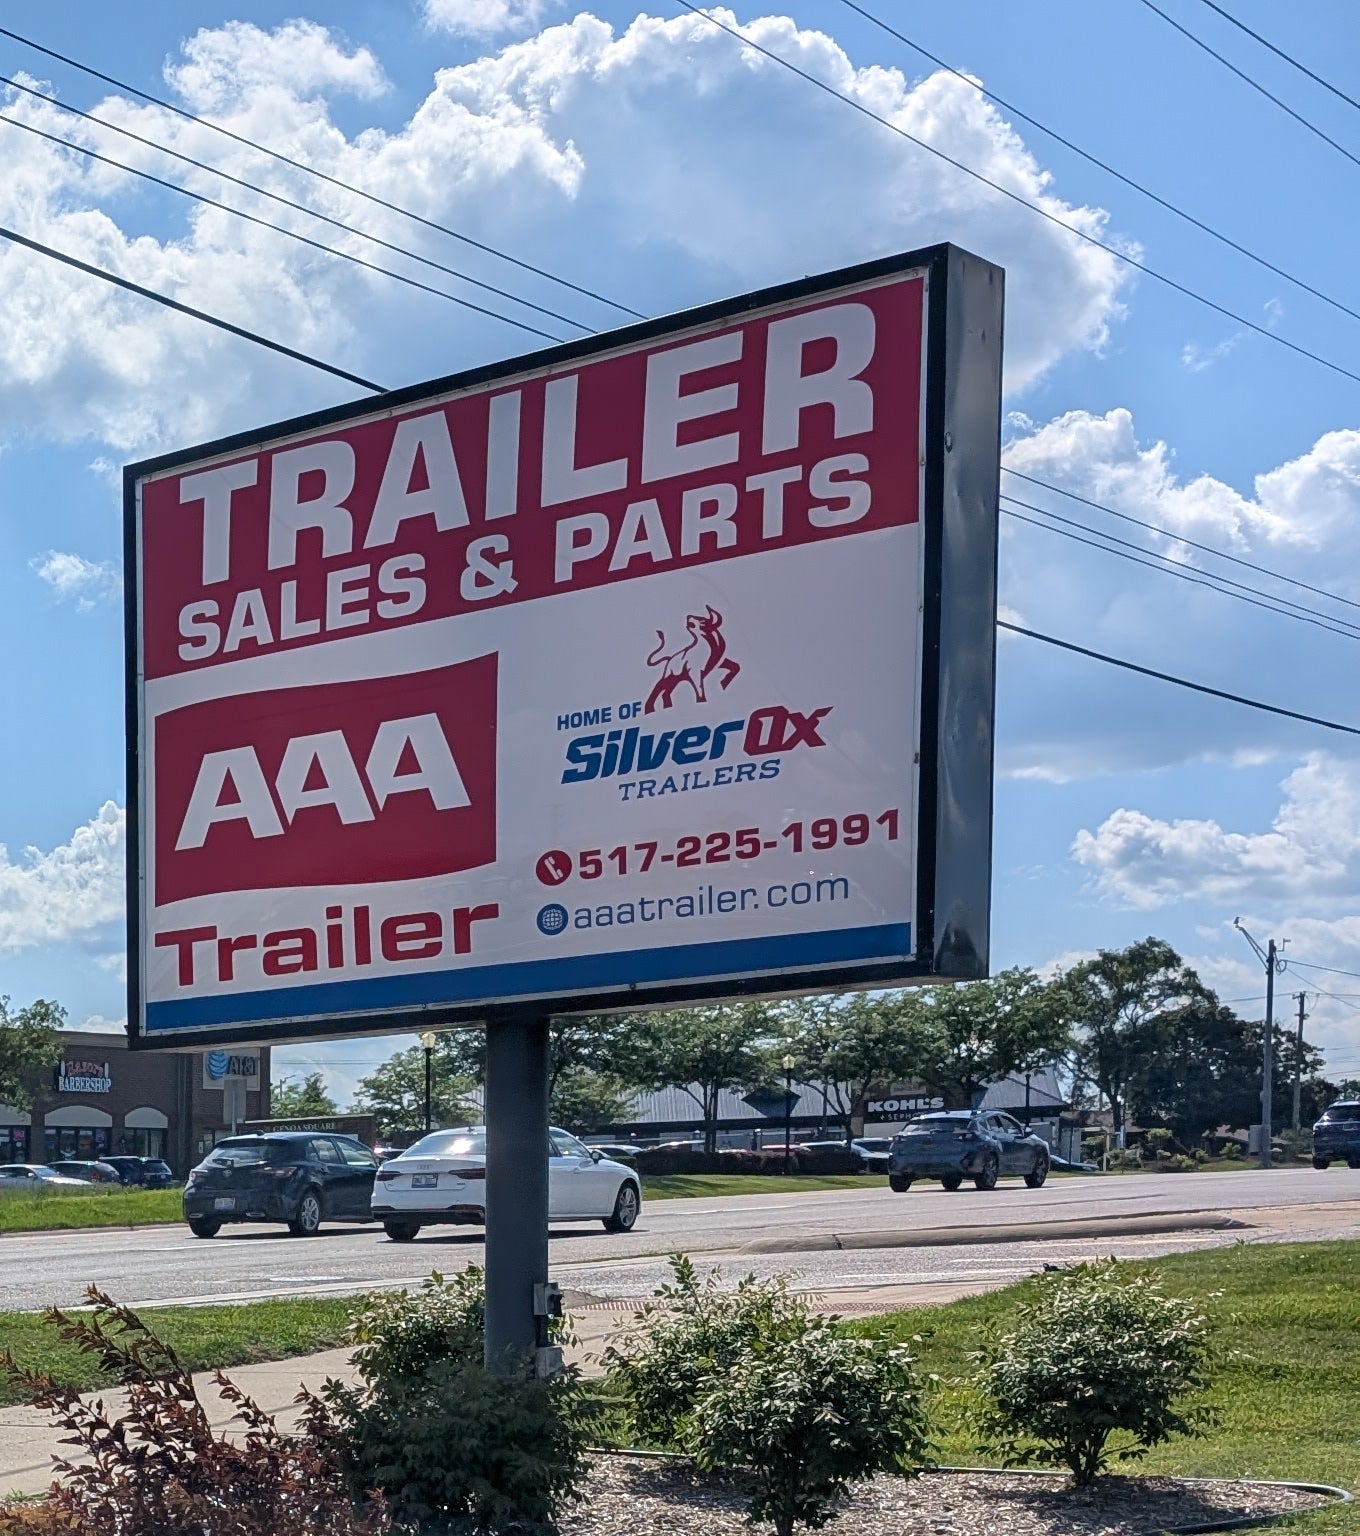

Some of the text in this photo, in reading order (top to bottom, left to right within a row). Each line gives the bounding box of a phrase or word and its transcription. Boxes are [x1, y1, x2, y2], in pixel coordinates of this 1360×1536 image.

[178, 302, 878, 587] TRAILER
[177, 451, 873, 662] SALES & PARTS
[556, 701, 643, 731] HOME OF
[174, 711, 473, 852] AAA
[618, 758, 782, 801] TRAILERS
[579, 808, 899, 880] 517-225-1991
[573, 876, 850, 930] aaatrailer.com
[154, 902, 500, 986] Trailer
[58, 1076, 112, 1093] BARBERSHOP
[230, 1055, 259, 1076] AT&T
[867, 1097, 944, 1113] KOHL'S
